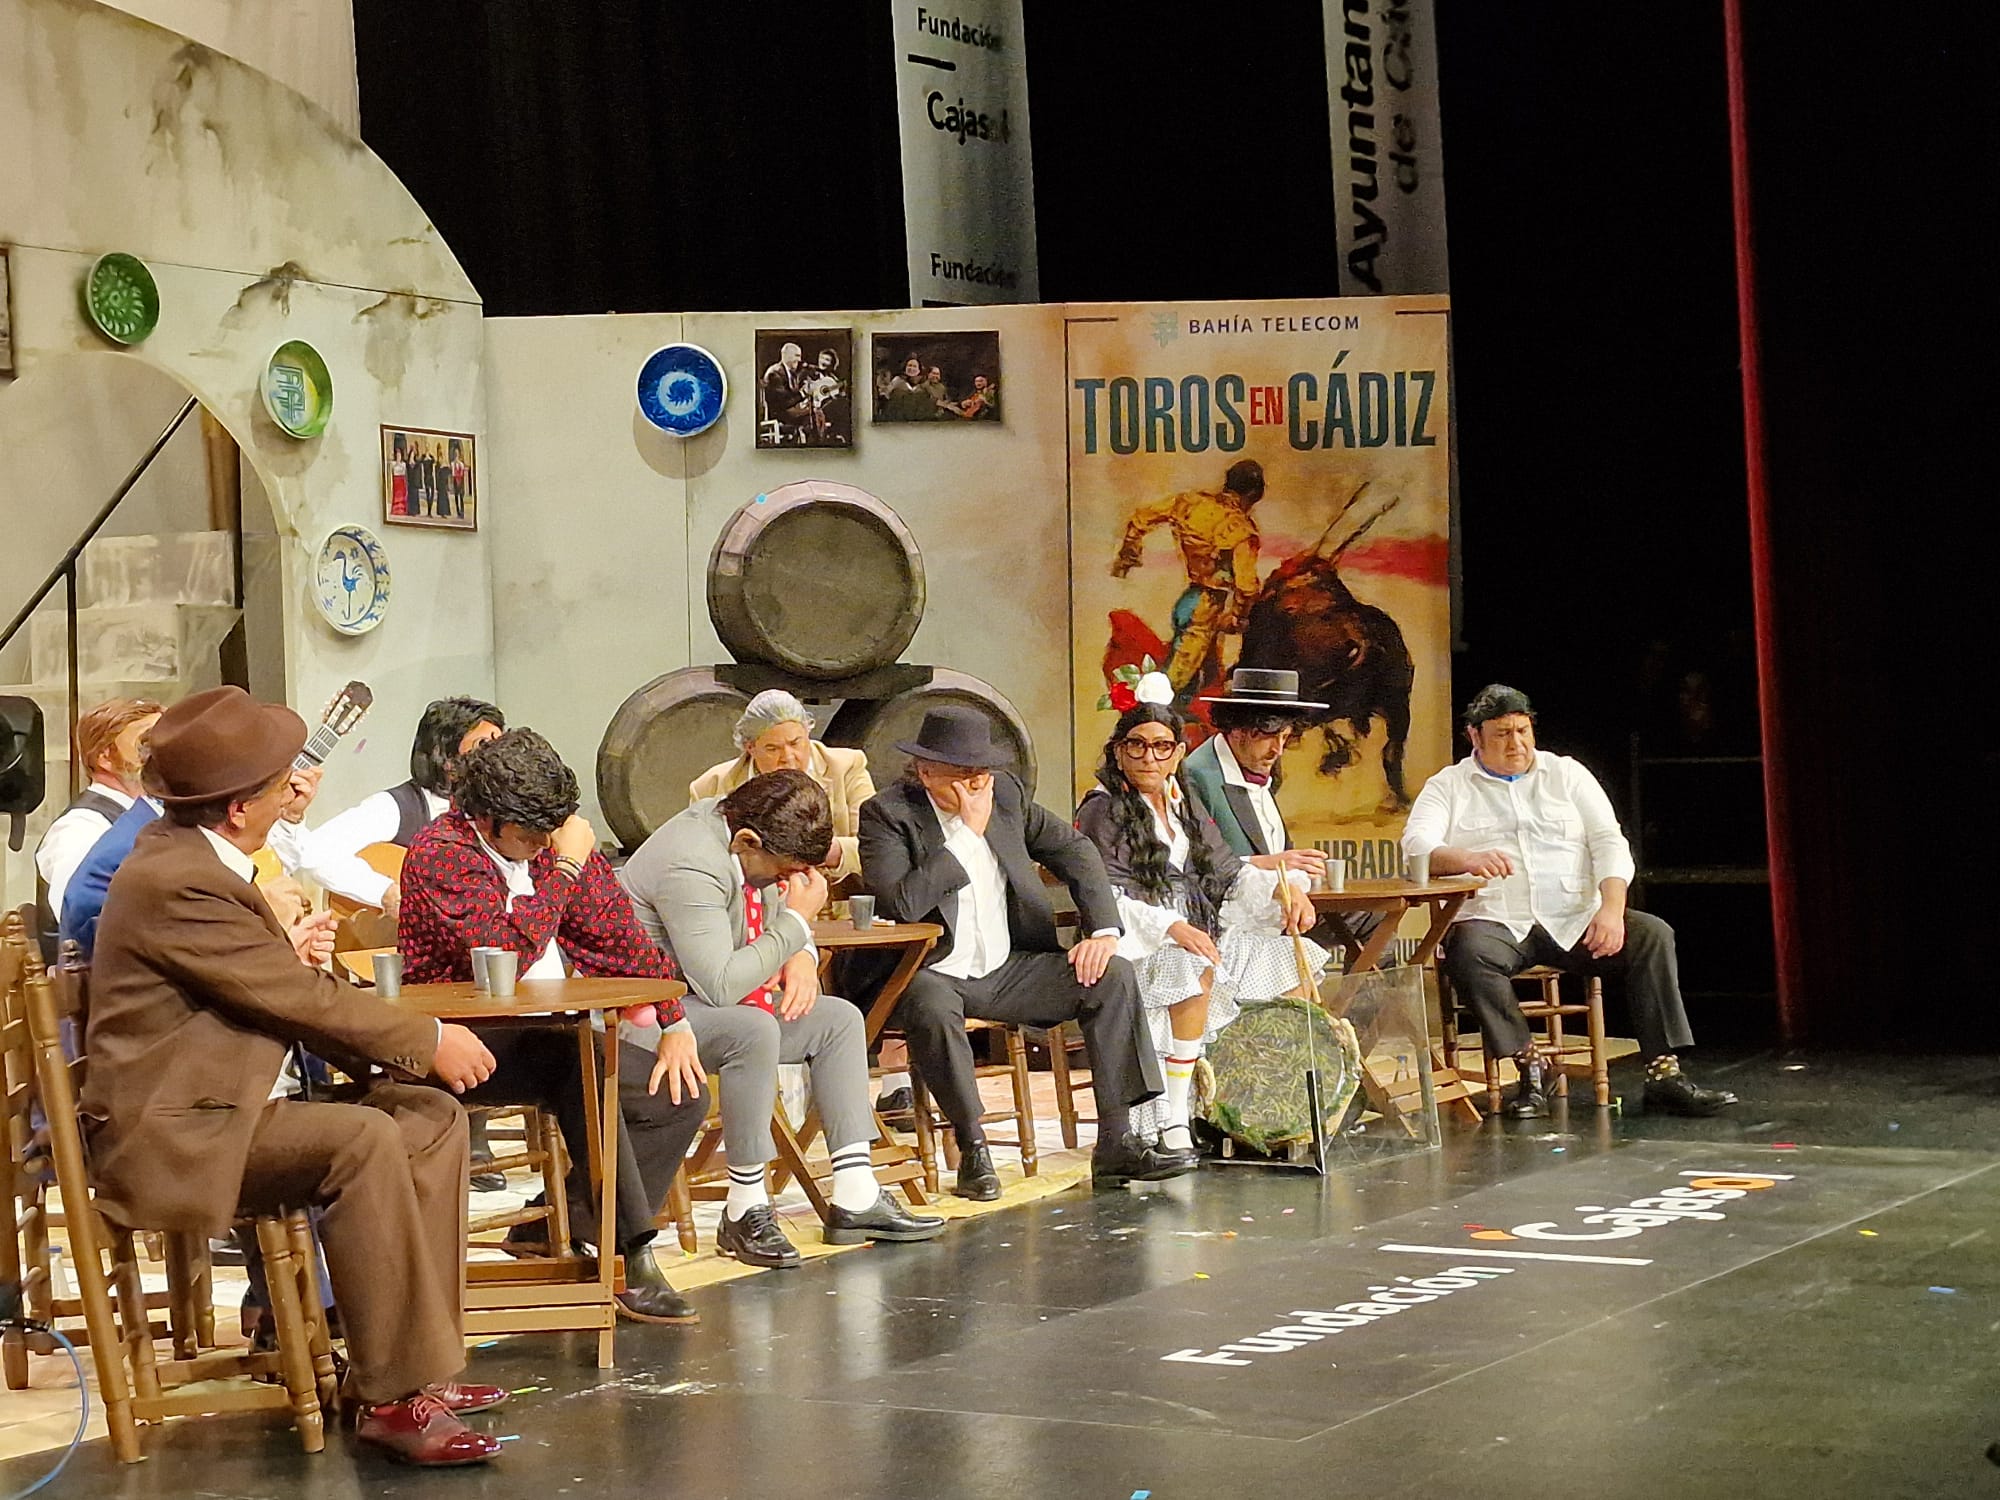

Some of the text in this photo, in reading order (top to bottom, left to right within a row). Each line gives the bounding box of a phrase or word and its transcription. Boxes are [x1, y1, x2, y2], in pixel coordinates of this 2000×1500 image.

[927, 91, 1010, 146] Cajasl
[1188, 314, 1360, 335] BAHÍA TELECOM
[1074, 349, 1437, 455] TOROS EN CÁDIZ
[1511, 1170, 1796, 1241] Cajasol
[1160, 1265, 1515, 1367] Fundación
